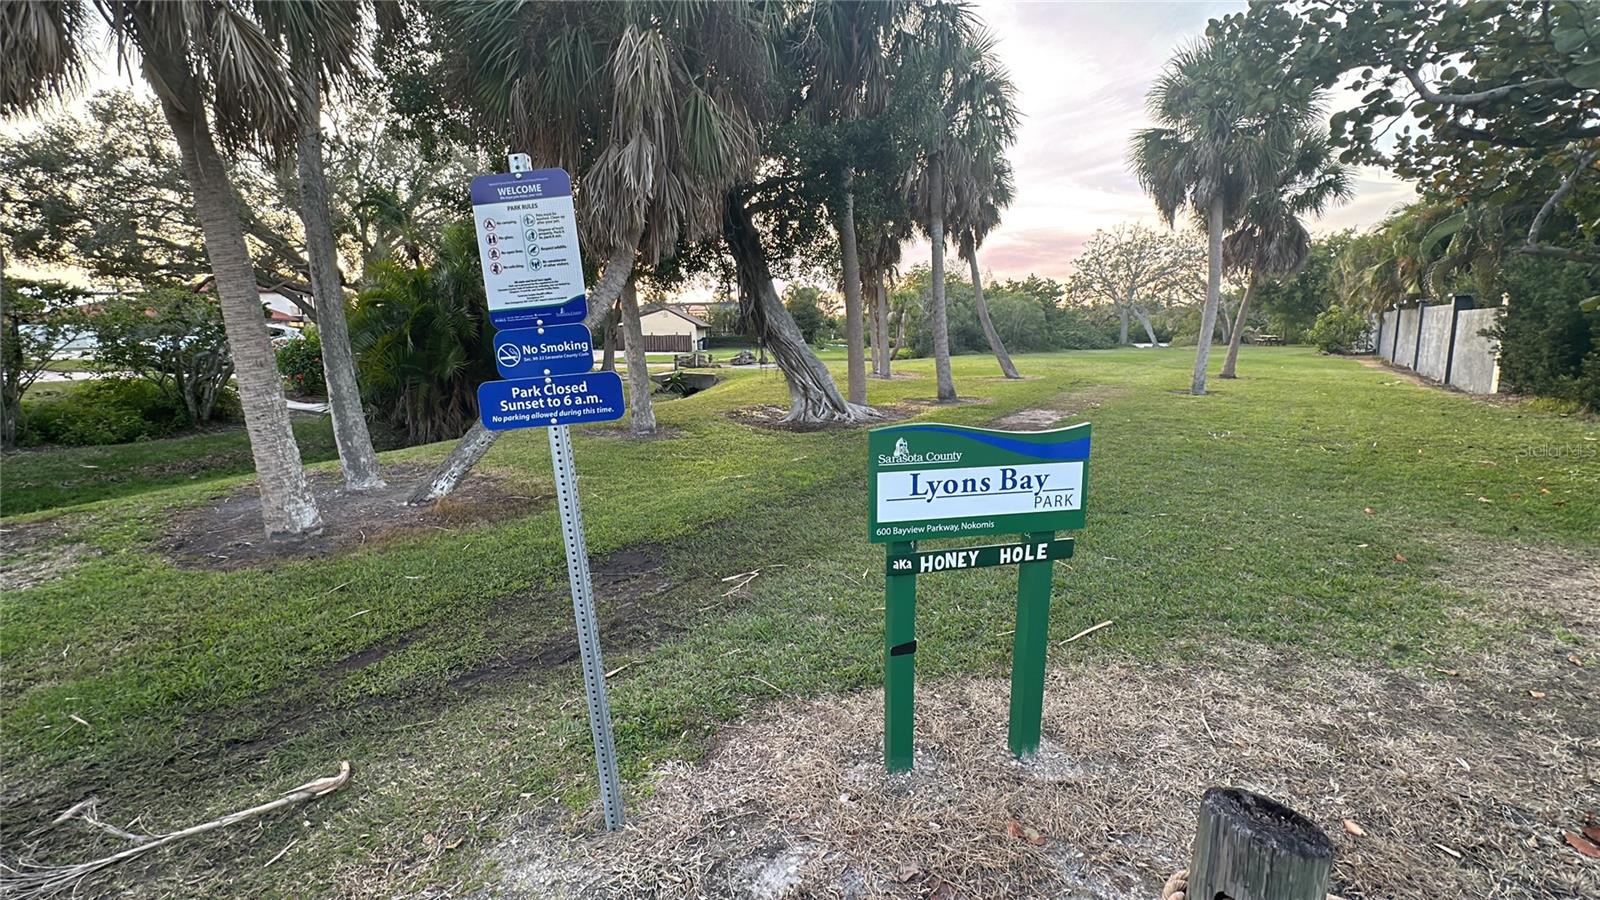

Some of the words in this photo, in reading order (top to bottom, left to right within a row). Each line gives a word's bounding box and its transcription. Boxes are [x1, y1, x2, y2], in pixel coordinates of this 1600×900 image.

[497, 184, 542, 196] WELCOME
[522, 345, 538, 354] No
[540, 341, 588, 353] Smoking
[512, 385, 542, 398] Park
[544, 381, 587, 396] Closed
[501, 399, 544, 412] Sunset
[547, 398, 561, 408] to
[563, 395, 572, 406] 6
[575, 395, 602, 405] a.m.
[503, 412, 530, 423] parking
[531, 410, 558, 418] allowed
[559, 408, 581, 418] during
[878, 453, 924, 464] Sarasota
[926, 451, 962, 463] County
[910, 473, 990, 503] Lyons
[1000, 468, 1050, 495] Bay
[1034, 494, 1073, 508] PARK
[876, 527, 892, 536] 600
[893, 525, 925, 536] Bayview
[927, 523, 960, 533] Parkway,
[962, 520, 995, 530] Nokomis
[920, 550, 980, 573] HONEY
[1000, 543, 1048, 565] HOLE
